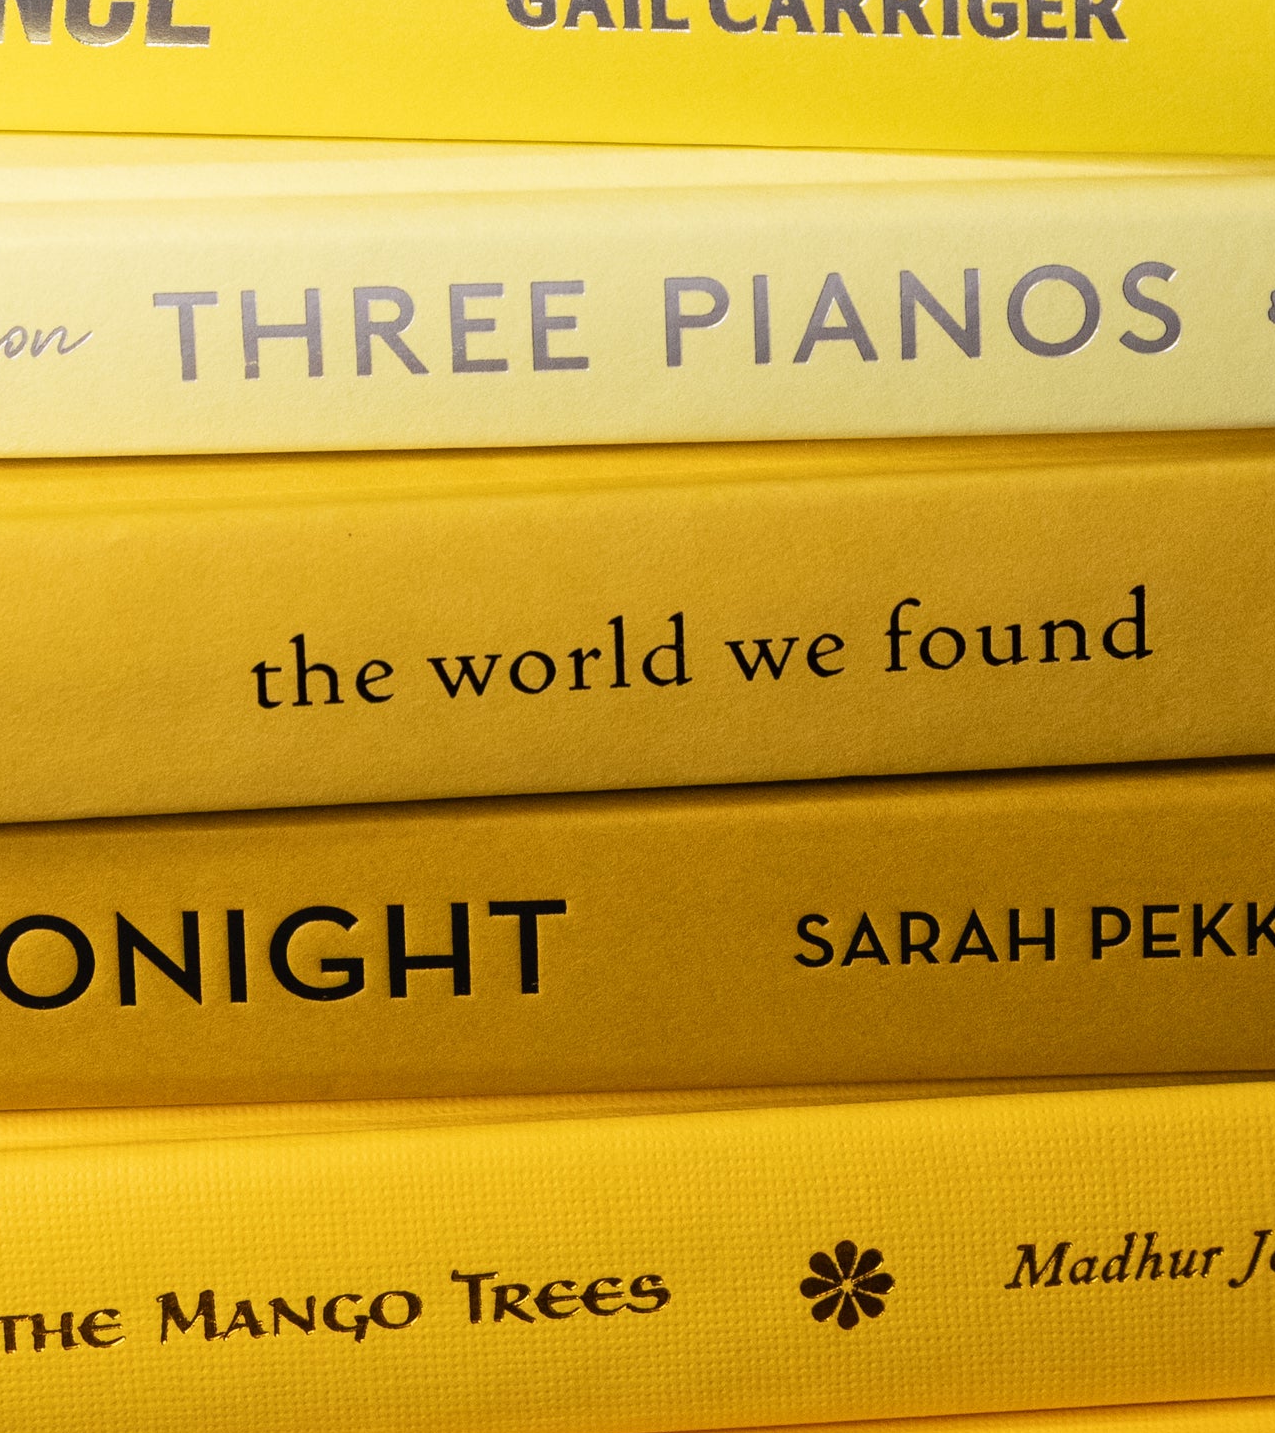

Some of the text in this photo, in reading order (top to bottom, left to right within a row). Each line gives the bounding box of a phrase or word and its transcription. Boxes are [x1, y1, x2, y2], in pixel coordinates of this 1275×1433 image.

[152, 260, 1182, 382] THREE PIANOS
[251, 584, 1155, 710] the world we found
[793, 907, 1055, 968] SARAH
[1004, 1231, 1224, 1291] Madhur
